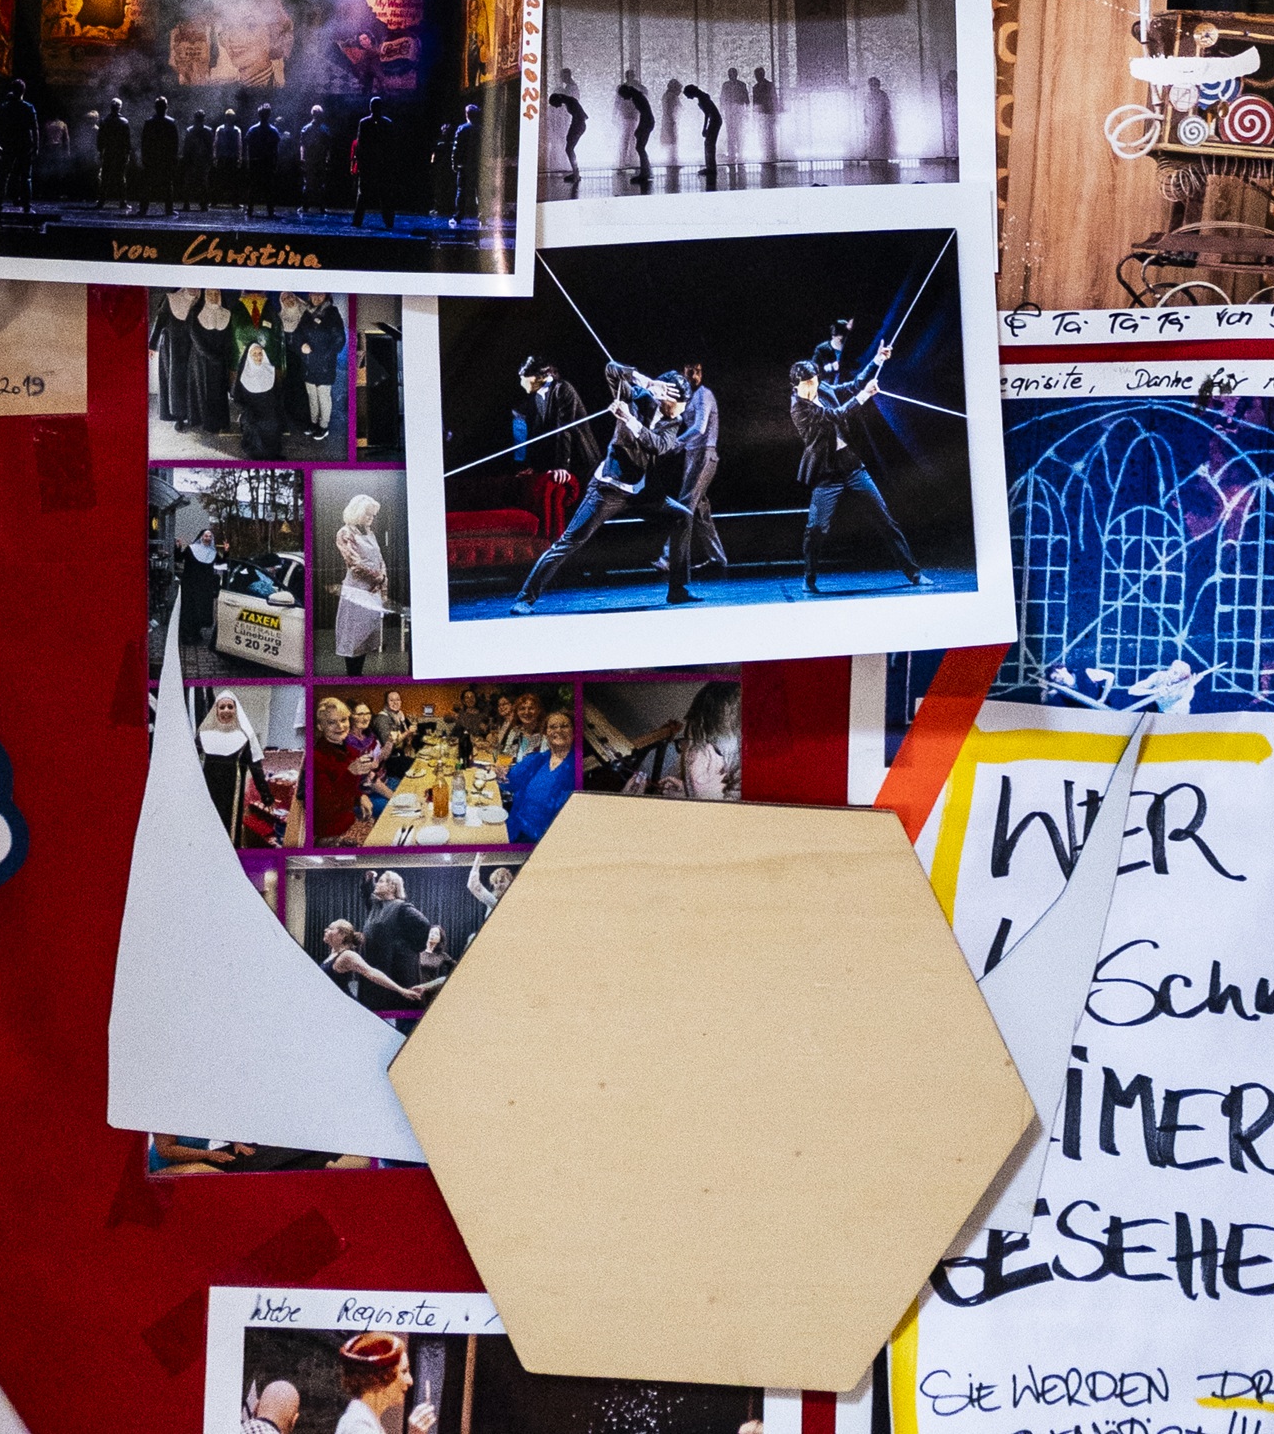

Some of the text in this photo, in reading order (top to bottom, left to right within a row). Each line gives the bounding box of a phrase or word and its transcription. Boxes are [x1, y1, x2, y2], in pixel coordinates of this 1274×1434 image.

[182, 234, 322, 269] Christina
[241, 611, 279, 627] TAXEN
[234, 635, 242, 645] 5
[244, 638, 260, 650] 20
